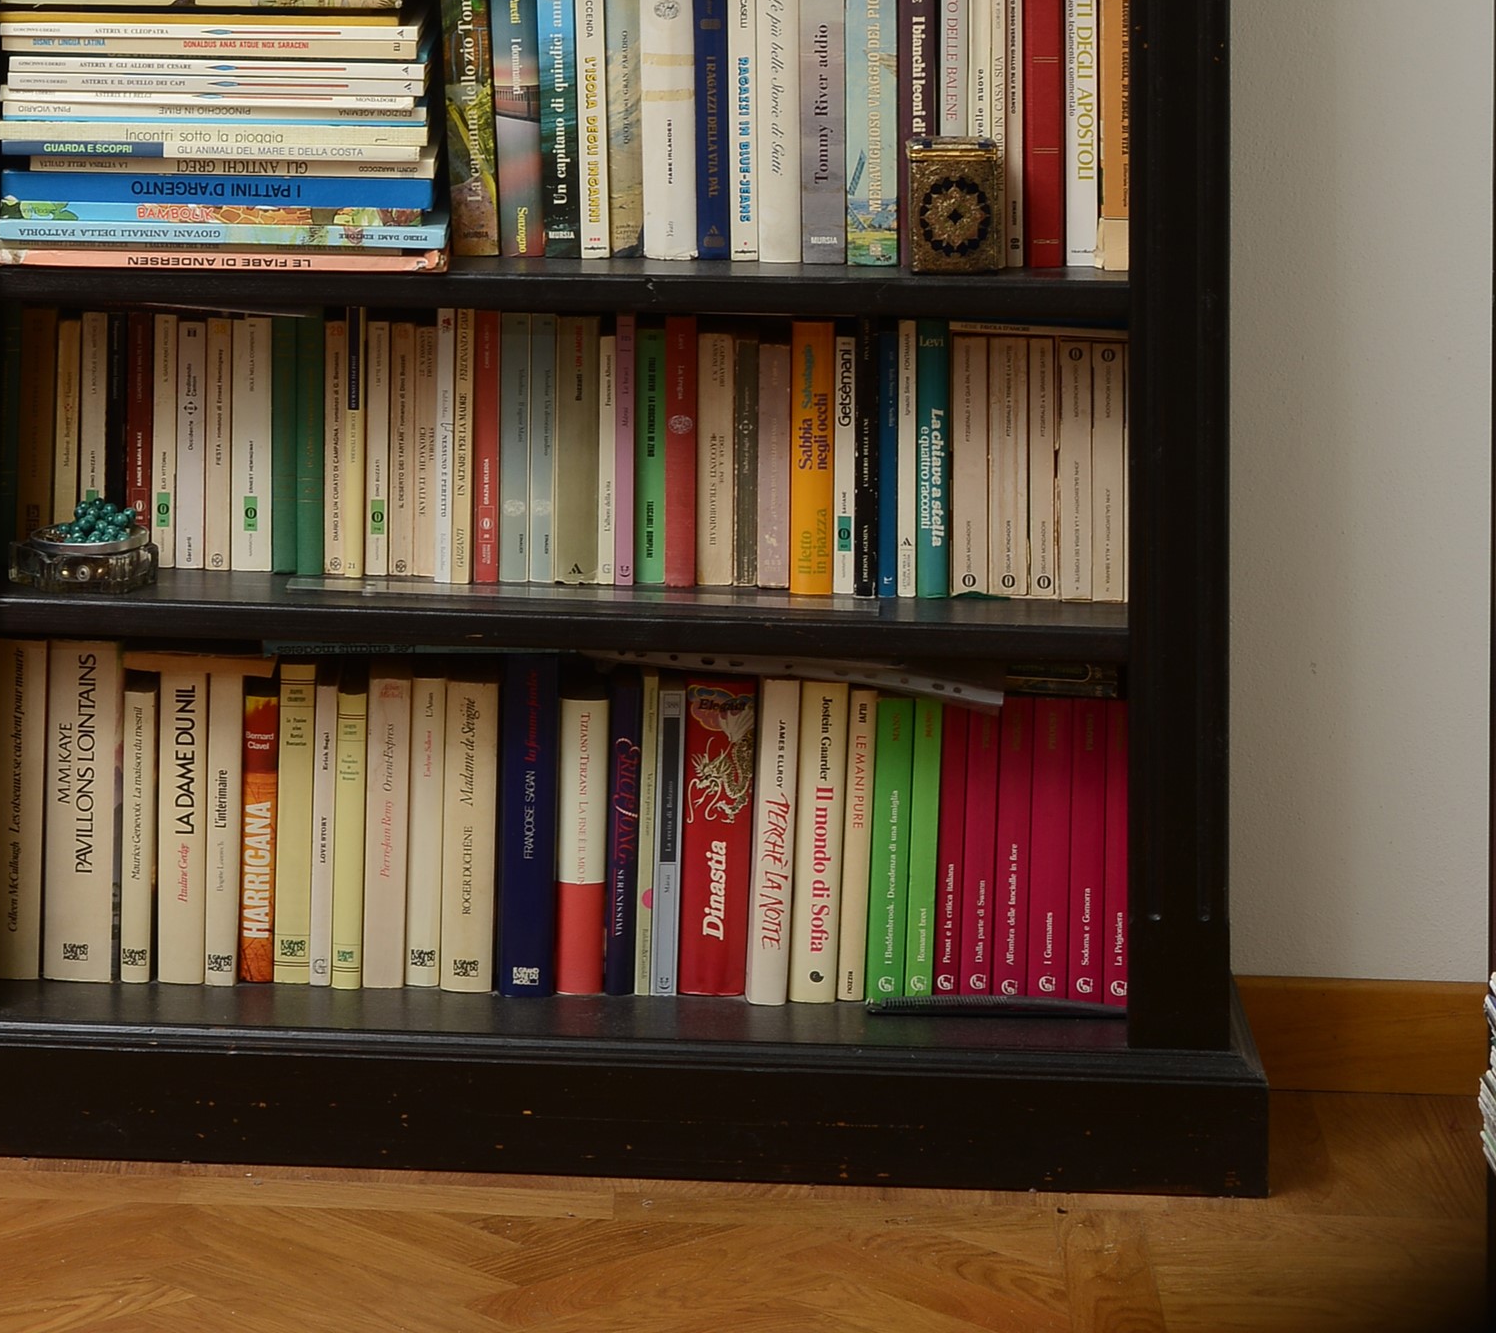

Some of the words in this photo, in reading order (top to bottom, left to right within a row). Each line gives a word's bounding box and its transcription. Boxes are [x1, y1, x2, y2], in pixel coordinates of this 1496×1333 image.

[814, 24, 828, 68] addio
[815, 75, 828, 119] River
[44, 143, 85, 154] GUARDA
[87, 144, 93, 153] E
[96, 144, 132, 154] SCOPRI
[815, 125, 833, 185] Tommy
[131, 180, 225, 197] D'ARGENTO
[230, 182, 291, 197] PATTINI
[814, 393, 828, 431] occhi
[799, 419, 812, 470] Sabbia
[814, 435, 830, 470] negli
[76, 653, 96, 763] LOINTAINS
[176, 685, 195, 712] NIL
[176, 717, 195, 745] DU
[176, 749, 195, 807] DAME
[816, 786, 834, 801] Il
[76, 766, 95, 873] PAVILLONS
[176, 811, 195, 835] LA
[812, 807, 831, 874] mondo
[244, 801, 271, 938] HARRICANA
[702, 840, 727, 940] Dinastia
[811, 879, 830, 899] di
[810, 904, 829, 953] Sofia
